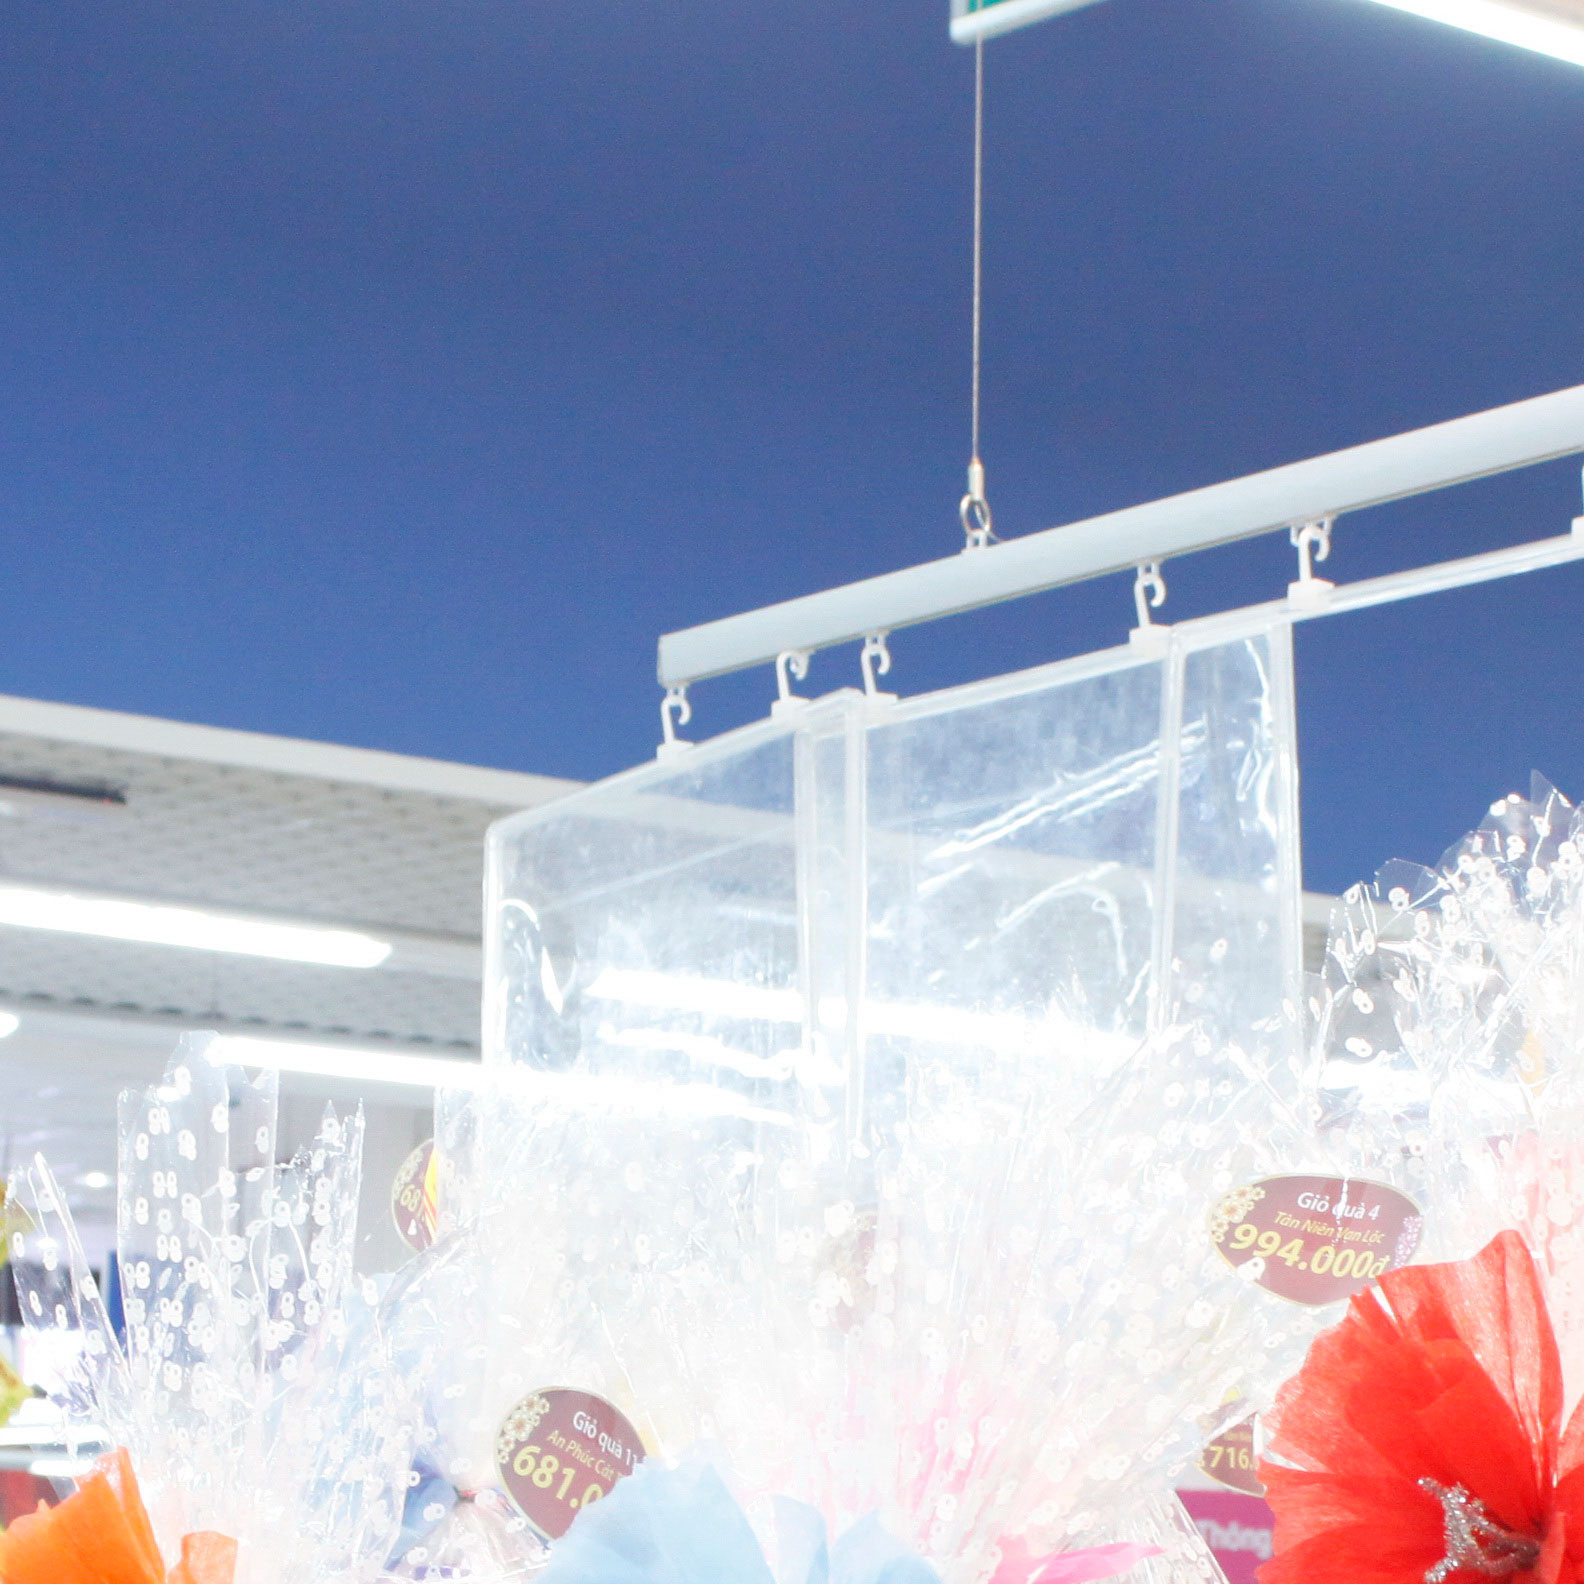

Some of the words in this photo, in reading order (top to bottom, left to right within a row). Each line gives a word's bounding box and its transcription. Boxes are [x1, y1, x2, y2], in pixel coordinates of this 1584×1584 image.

[1297, 1191, 1331, 1213] Giỏ
[1367, 1203, 1383, 1221] 4
[1301, 1215, 1336, 1239] Niên
[1361, 1228, 1386, 1247] Lộc
[1228, 1223, 1391, 1280] 994.000đ
[547, 1430, 566, 1449] An
[566, 1440, 595, 1470] Phúc
[572, 1409, 598, 1439] Giỏ
[597, 1432, 623, 1461] quà
